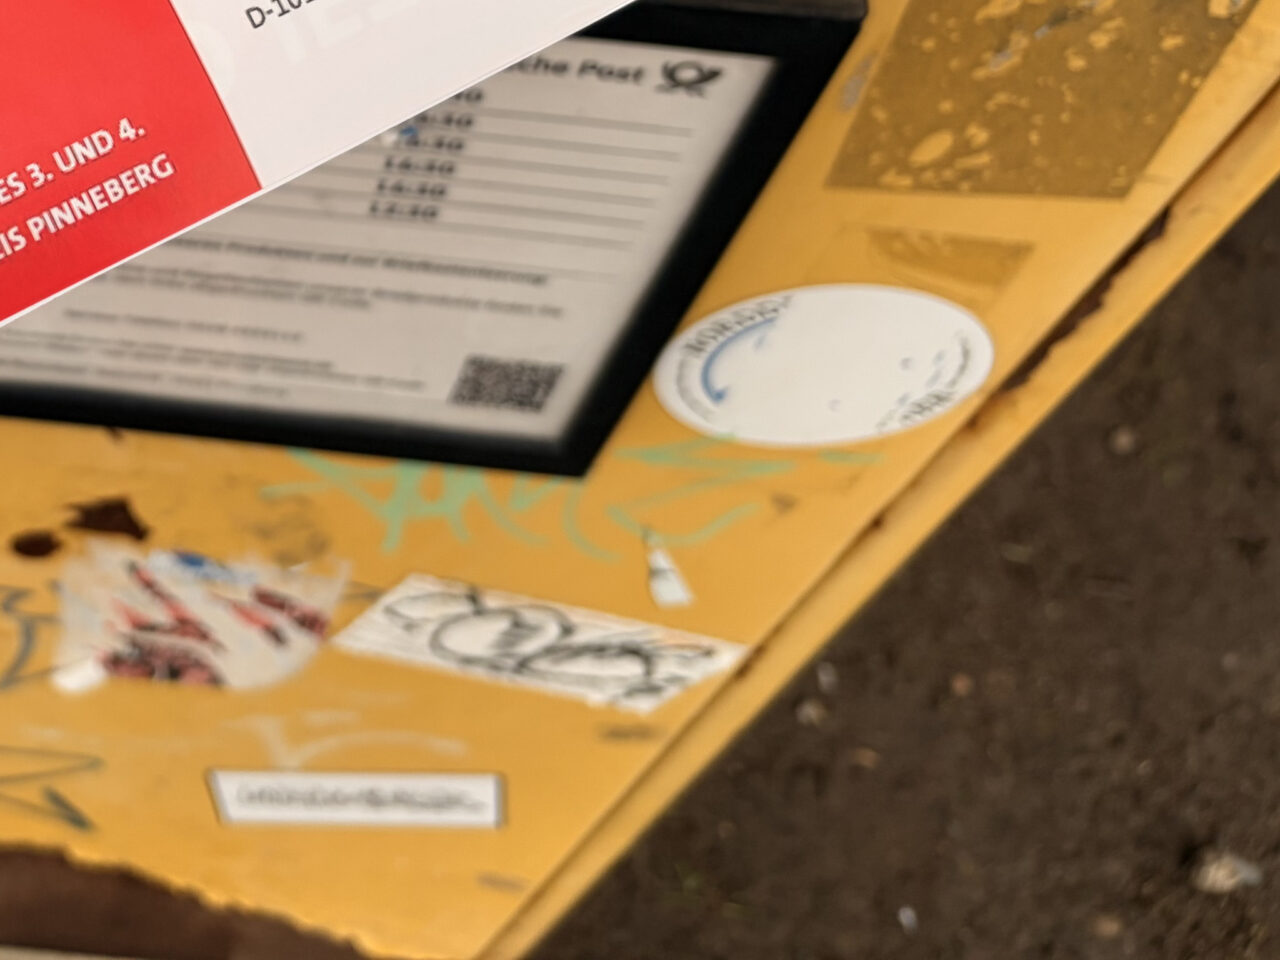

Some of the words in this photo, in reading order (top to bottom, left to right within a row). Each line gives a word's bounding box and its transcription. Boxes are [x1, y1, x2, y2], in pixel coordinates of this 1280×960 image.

[27, 163, 55, 188] 3.
[52, 129, 115, 172] UND
[119, 118, 146, 141] 4.
[26, 153, 175, 241] PINNEBERG
